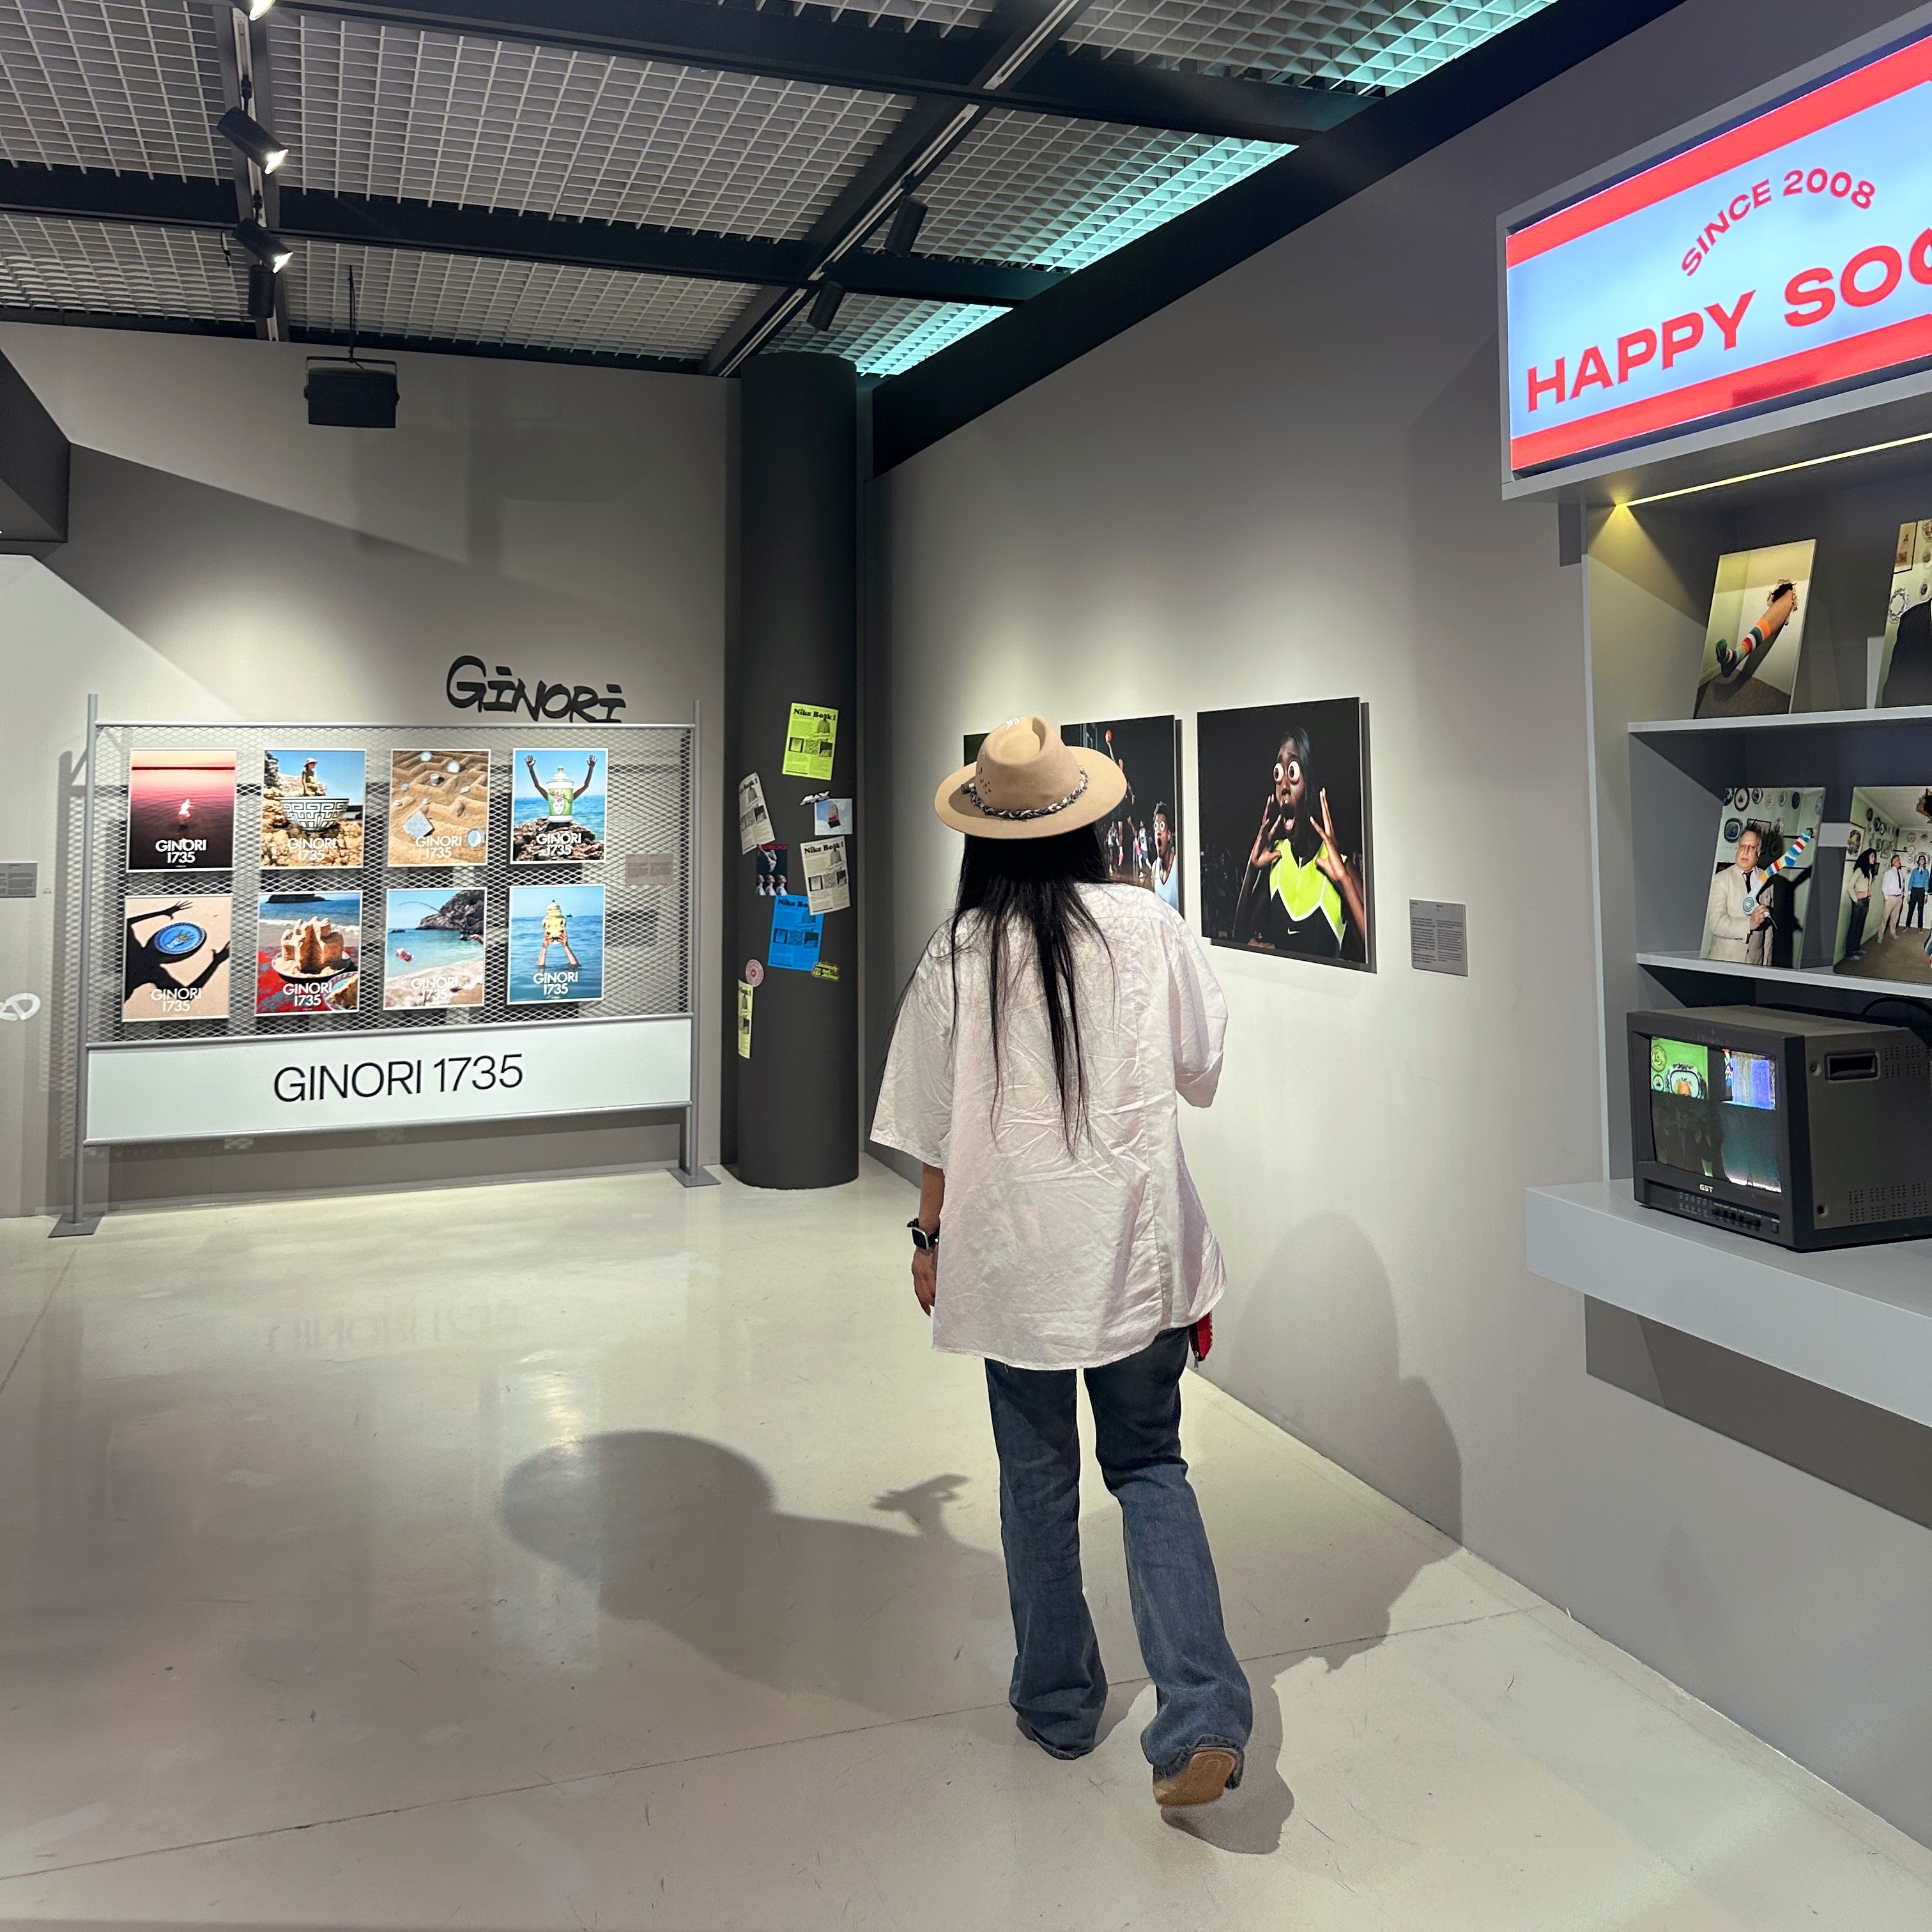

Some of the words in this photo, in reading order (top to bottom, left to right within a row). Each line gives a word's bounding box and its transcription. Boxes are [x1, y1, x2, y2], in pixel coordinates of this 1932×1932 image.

[1682, 179, 1772, 276] SINCE
[1782, 168, 1876, 210] 2008
[1527, 289, 1756, 413] HAPPY
[288, 838, 337, 849] GINORI
[415, 836, 462, 847] GINORI
[536, 833, 582, 845] GINORI
[155, 839, 207, 852] GINORI
[547, 845, 572, 855] 1735
[804, 845, 822, 854] Nike
[167, 852, 195, 864] 1735
[298, 850, 325, 861] 1735
[426, 847, 452, 859] 1735
[411, 977, 458, 990] GINORI
[533, 972, 578, 984] GINORI
[151, 988, 202, 1000] GINORI
[282, 983, 332, 995] GINORI
[422, 988, 448, 1001] 1735
[544, 983, 569, 995] 1735
[162, 1000, 190, 1012] 1735
[294, 994, 321, 1006] 1735
[274, 1060, 422, 1102] GINORI
[434, 1054, 523, 1092] 1735
